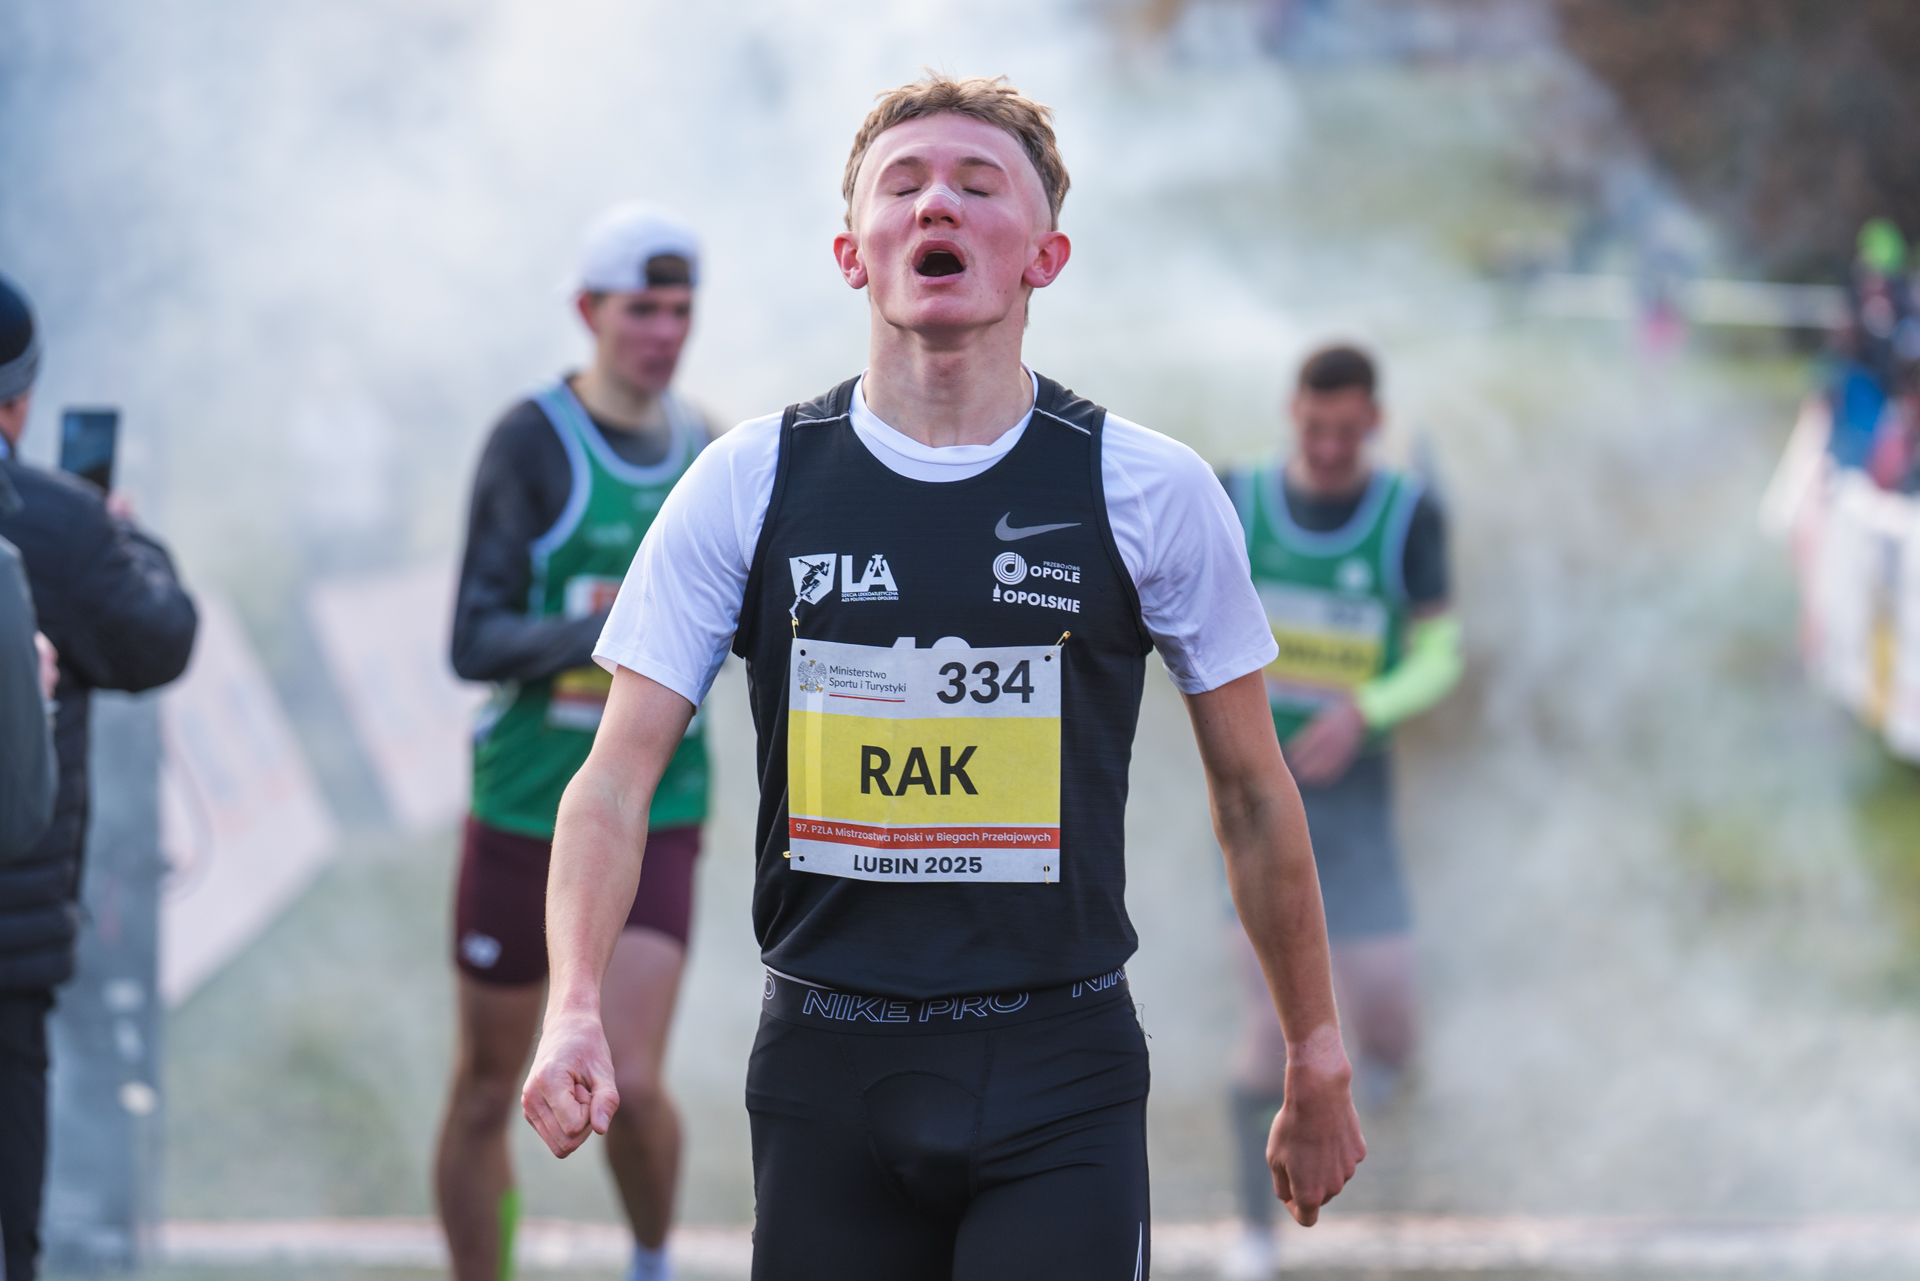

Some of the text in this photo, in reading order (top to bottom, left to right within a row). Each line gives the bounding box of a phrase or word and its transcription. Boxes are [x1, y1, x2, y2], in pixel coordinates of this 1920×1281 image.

[841, 554, 898, 592] LA
[1030, 566, 1080, 583] OPOLE
[1003, 590, 1080, 613] OPOLSKIE
[829, 665, 886, 679] Ministerstwo
[936, 660, 1034, 704] 334
[829, 677, 858, 689] Sportu
[866, 680, 906, 693] Turystyki
[861, 744, 979, 796] RAK
[795, 823, 1051, 844] 97. PZLA Mistrzostwa Polski w Biegach Przełajowych
[853, 854, 982, 874] LUBIN 2025
[803, 990, 912, 1022] NIKE
[919, 991, 1029, 1022] PRO
